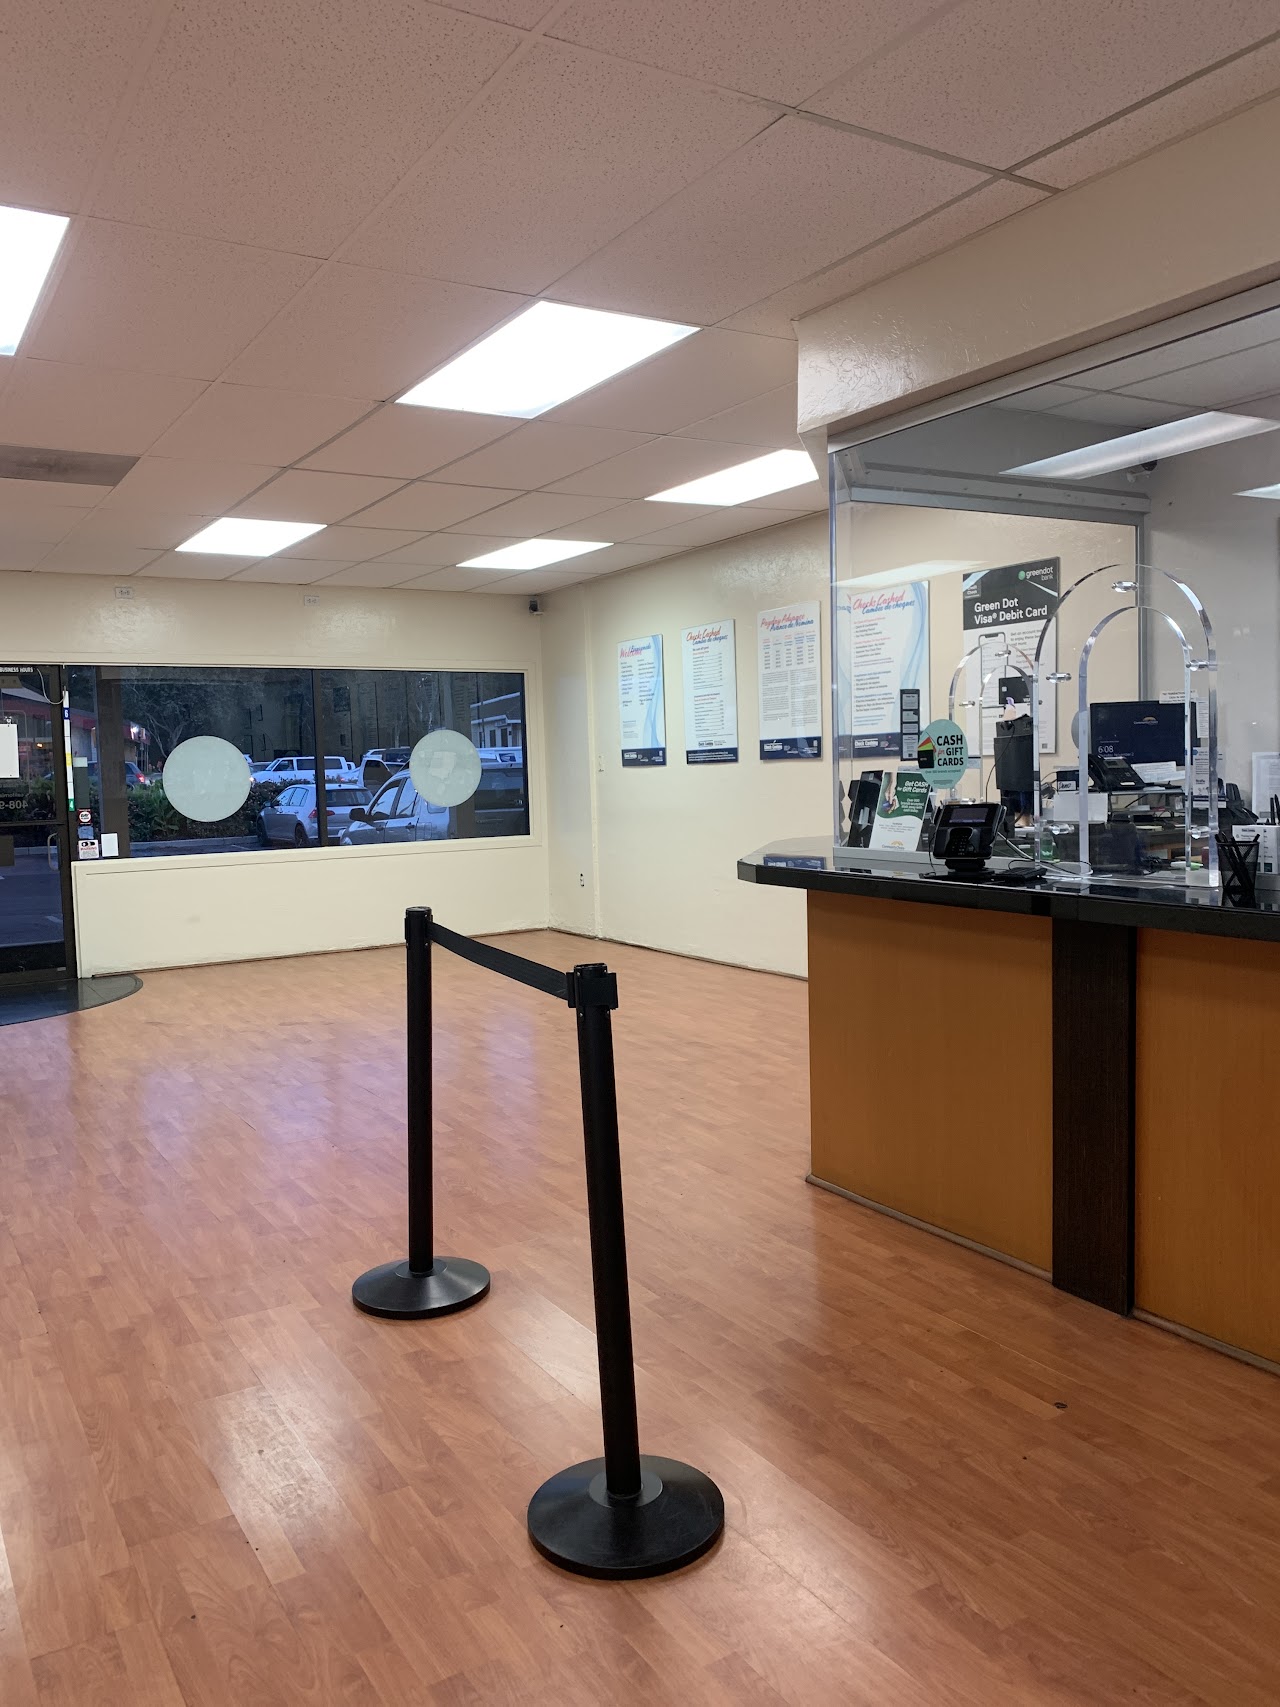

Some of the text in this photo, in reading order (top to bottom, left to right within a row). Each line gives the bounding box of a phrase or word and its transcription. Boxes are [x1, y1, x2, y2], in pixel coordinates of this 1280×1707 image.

[1026, 566, 1053, 579] greendot
[853, 596, 876, 610] Checks
[877, 590, 905, 607] Cashed
[974, 598, 1018, 612] Green Dot
[999, 609, 1023, 621] Debit
[1025, 605, 1047, 617] Card
[760, 613, 805, 629] Payday Advance
[64, 709, 69, 718] 6
[936, 735, 963, 746] CASH
[946, 747, 964, 756] GIFT
[1098, 745, 1113, 753] 6:08
[937, 757, 964, 766] CARDS
